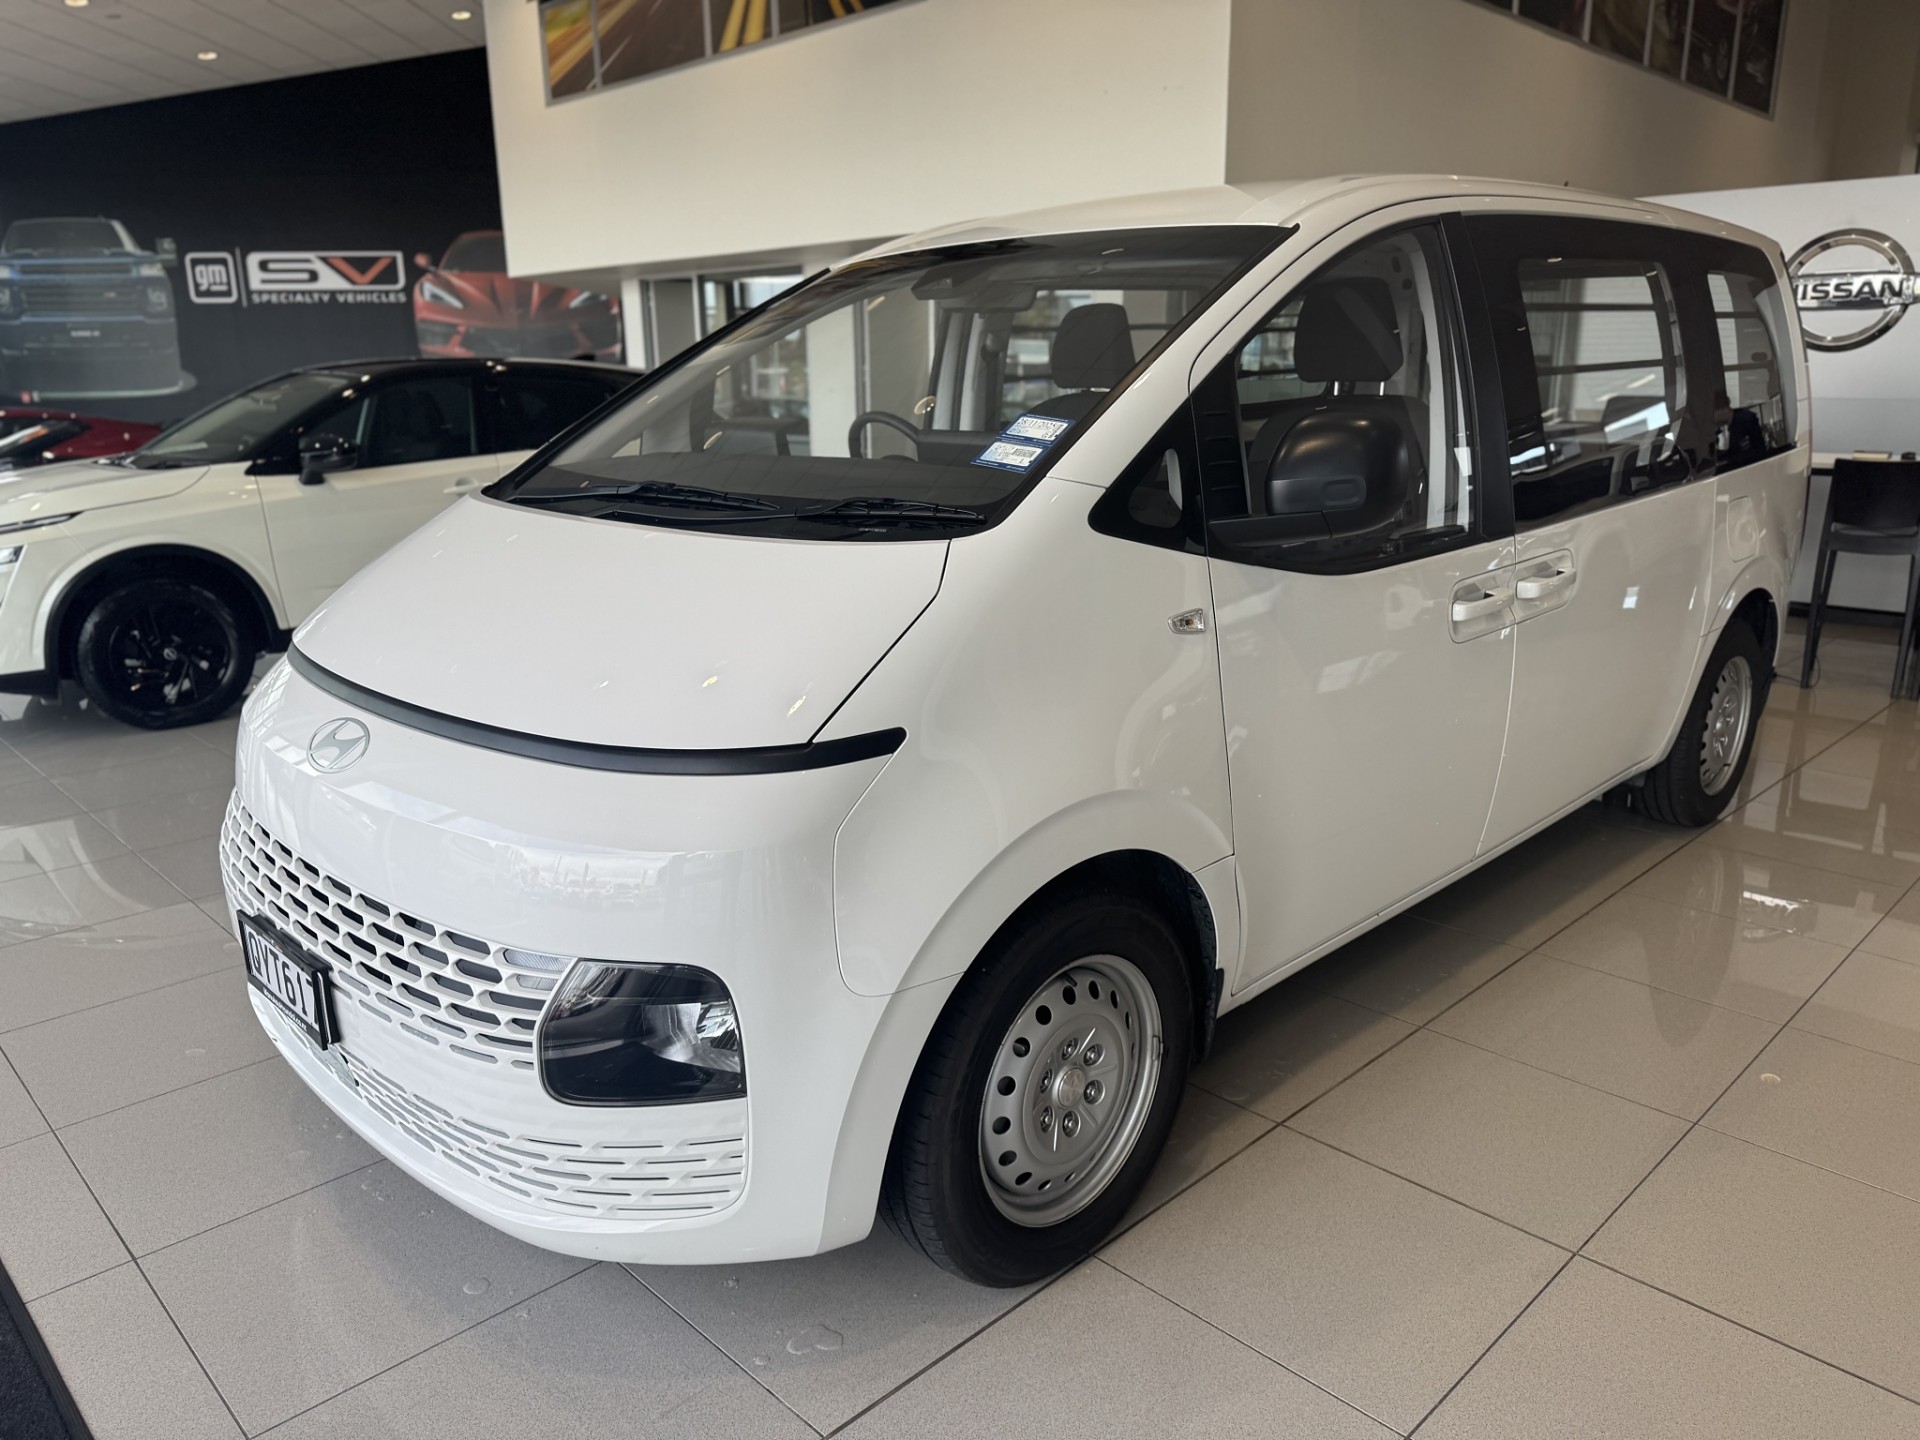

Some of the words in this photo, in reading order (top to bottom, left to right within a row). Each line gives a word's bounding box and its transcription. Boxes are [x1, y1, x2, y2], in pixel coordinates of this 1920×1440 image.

[194, 264, 228, 291] gm
[258, 256, 394, 285] SV
[251, 293, 331, 304] SPECIALTY
[335, 292, 407, 304] VEHICLES
[1793, 280, 1904, 301] ISSAN
